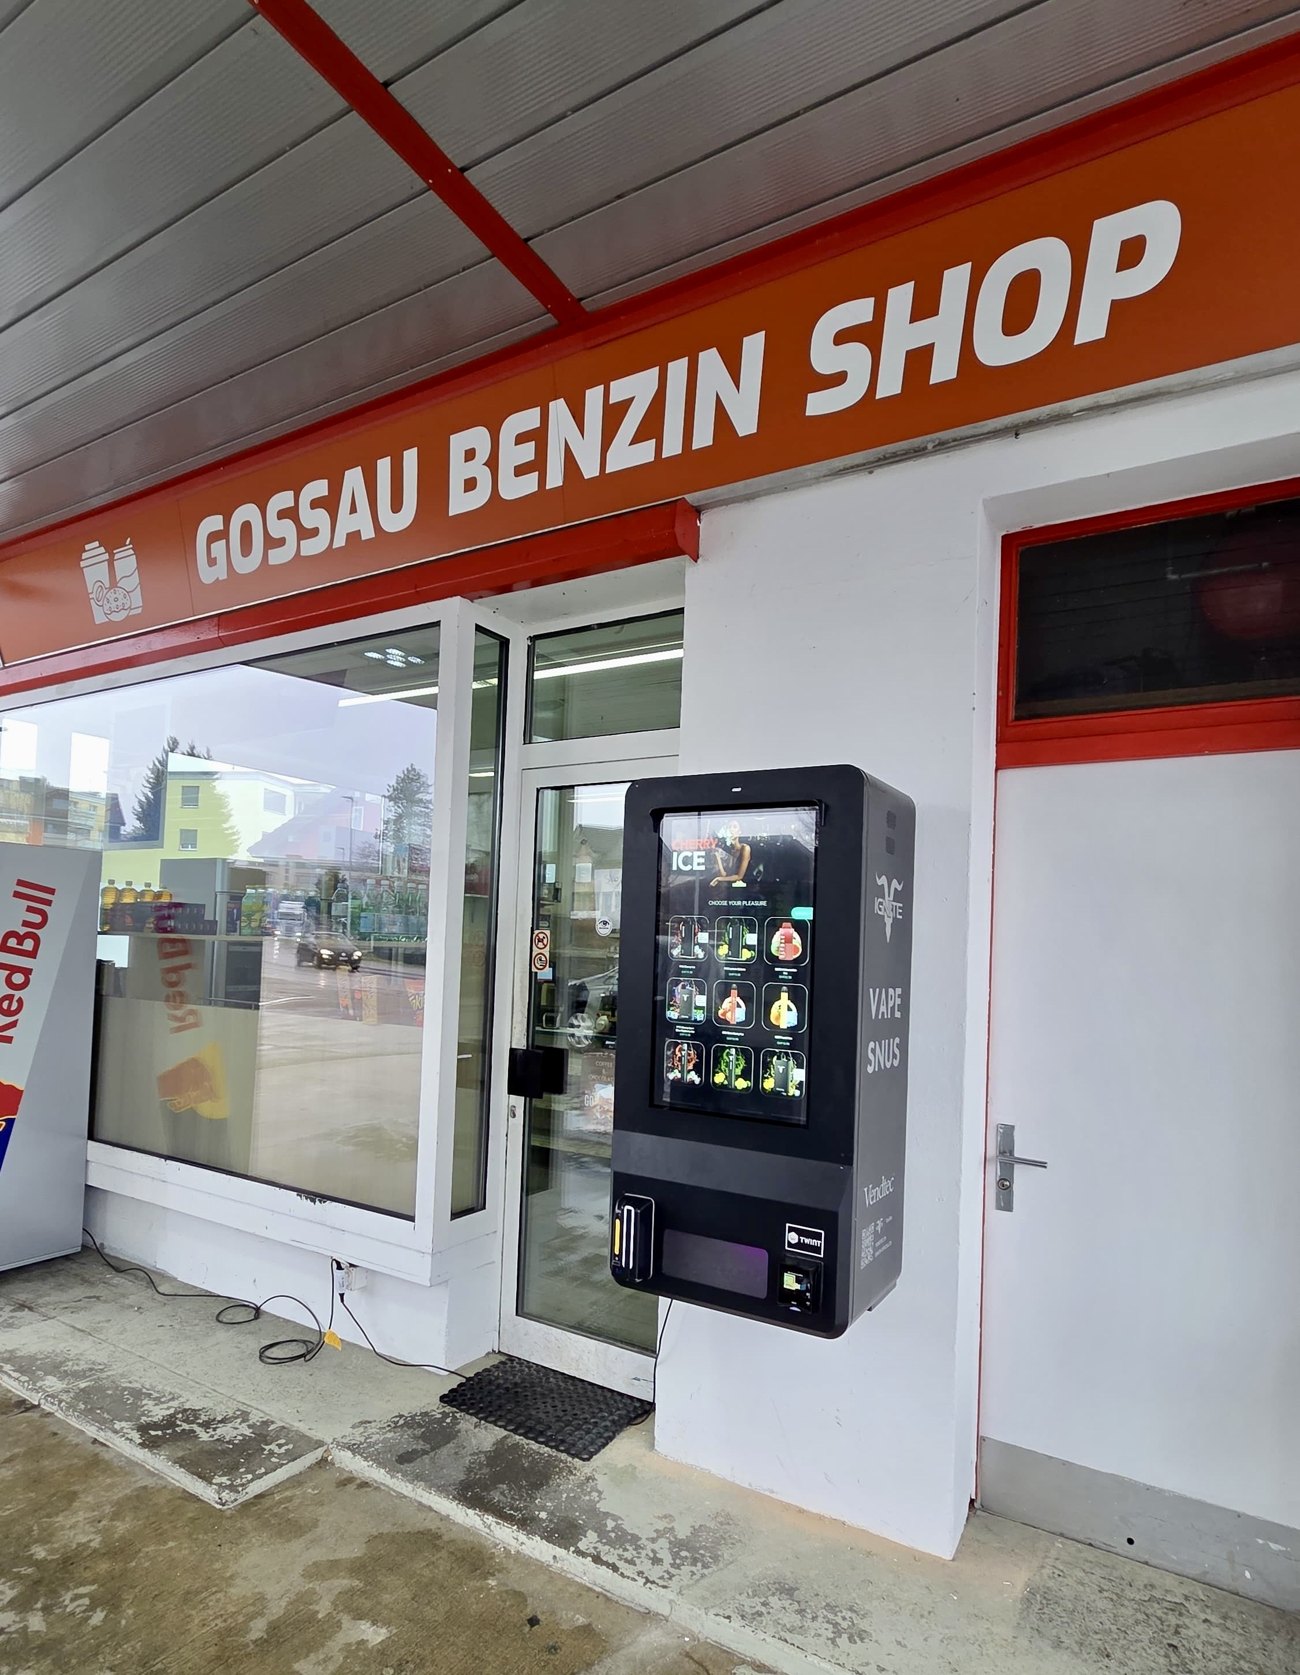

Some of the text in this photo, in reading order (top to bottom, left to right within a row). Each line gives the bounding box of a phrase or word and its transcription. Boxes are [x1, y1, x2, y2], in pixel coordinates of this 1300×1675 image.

[195, 200, 1182, 587] GOSSAU BENZIN SHOP
[671, 837, 718, 850] CHERRY
[671, 850, 706, 871] ICE
[0, 877, 57, 960] Bull
[869, 987, 902, 1020] VAPE
[866, 1036, 900, 1074] SNUS
[799, 1236, 822, 1248] TWINT
